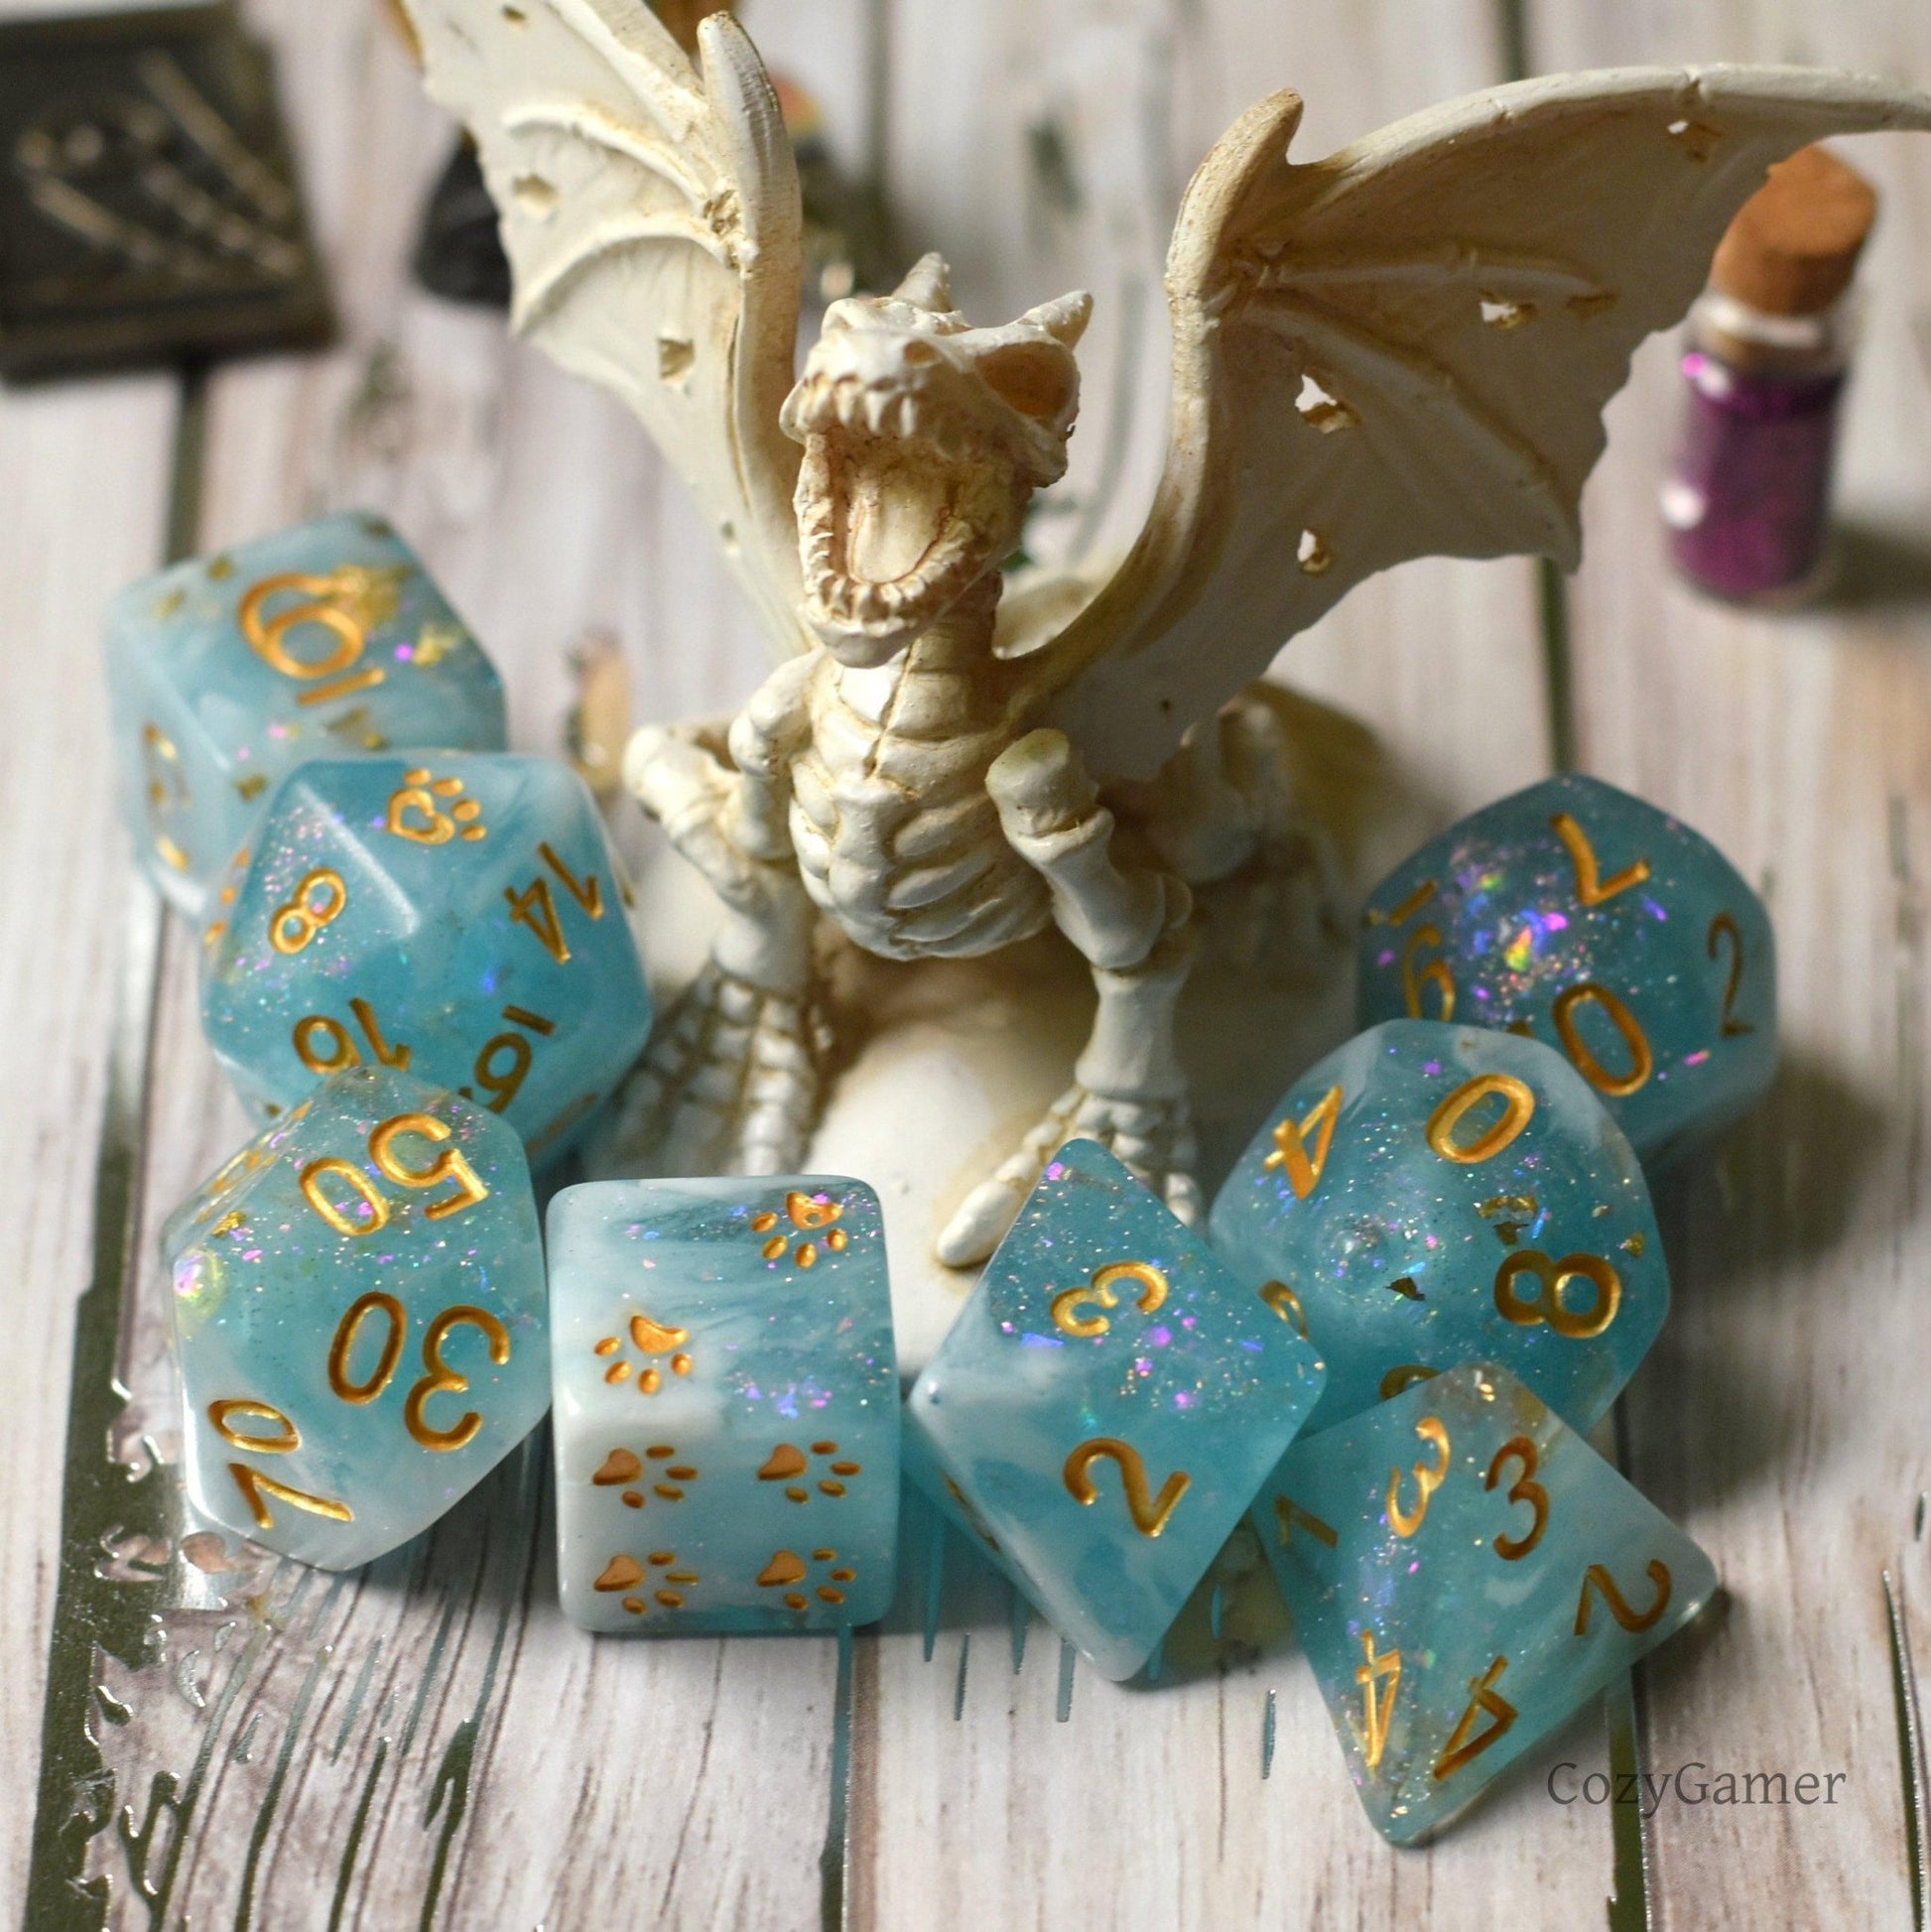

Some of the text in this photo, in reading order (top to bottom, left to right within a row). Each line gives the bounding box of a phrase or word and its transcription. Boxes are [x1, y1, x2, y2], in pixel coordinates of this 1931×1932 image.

[268, 868, 346, 955] 8
[504, 841, 604, 966] 14
[300, 1112, 489, 1236] 50
[1263, 1085, 1343, 1200] 4
[1425, 1073, 1535, 1164] 0
[1051, 1261, 1169, 1338] 3
[1494, 1249, 1621, 1338] 8
[328, 1290, 511, 1452] 30
[1064, 1438, 1191, 1537] 2
[1385, 1416, 1450, 1537] 3
[1484, 1436, 1549, 1560] 3
[1574, 1558, 1671, 1636] 2
[1355, 1629, 1401, 1769] 4
[1434, 1654, 1518, 1781] 4
